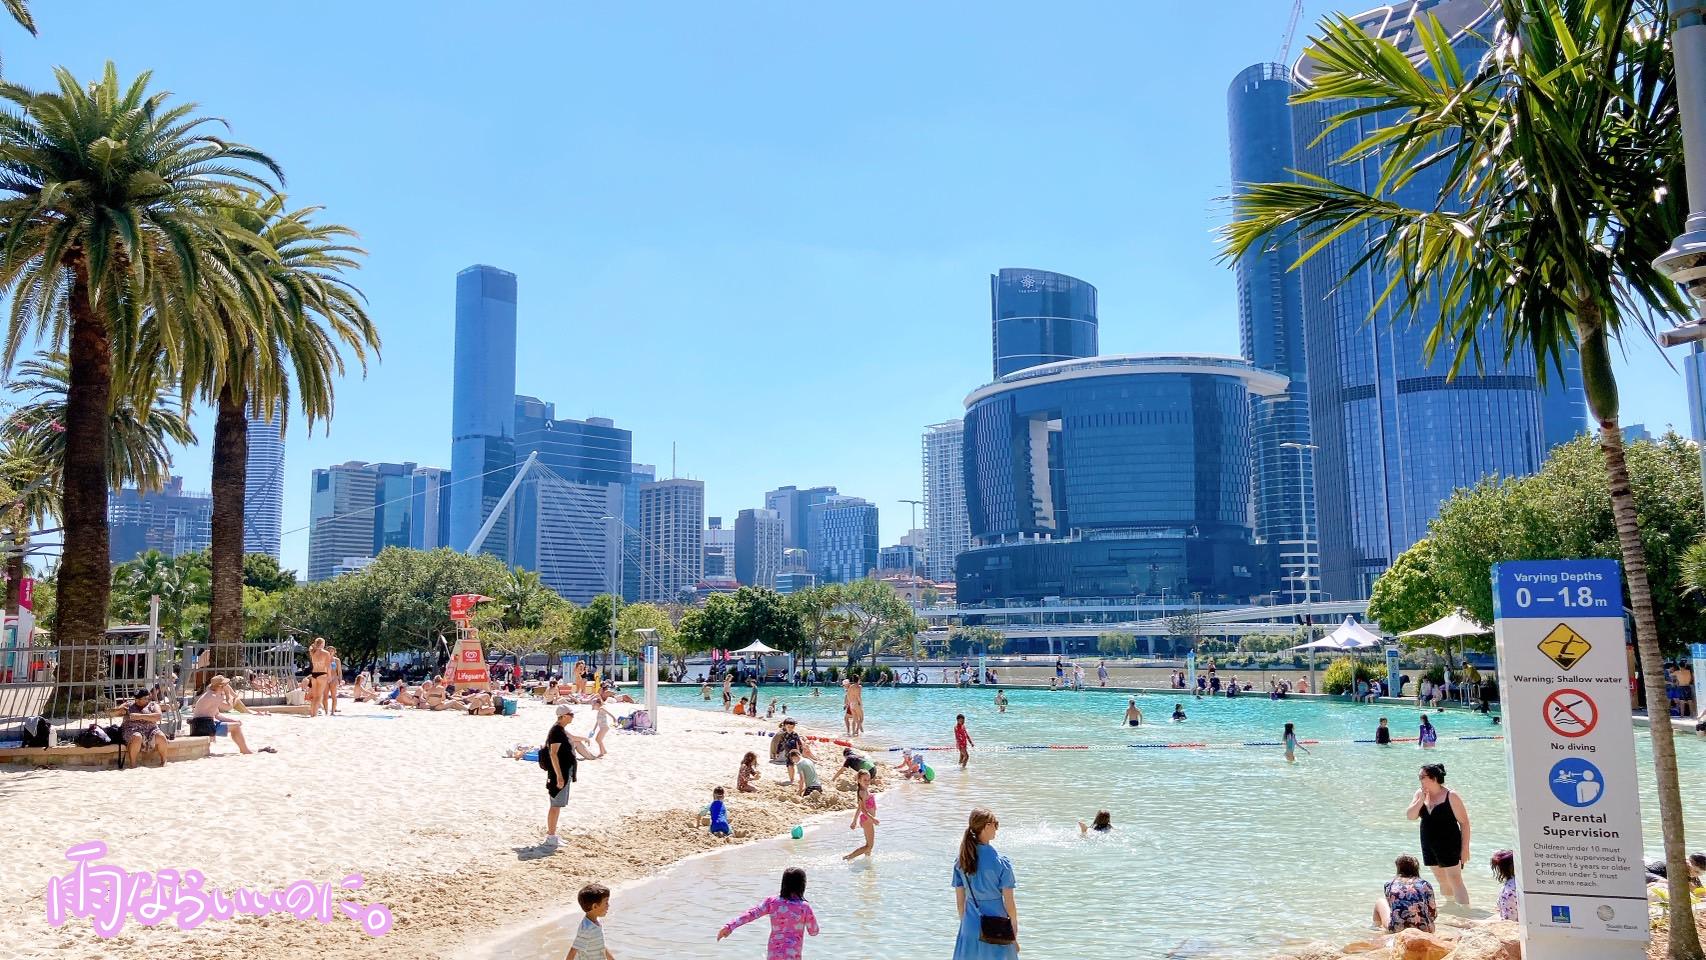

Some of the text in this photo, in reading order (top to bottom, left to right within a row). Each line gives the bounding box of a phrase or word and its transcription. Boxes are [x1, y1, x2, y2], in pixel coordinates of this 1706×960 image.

[1513, 572, 1603, 583] Varying Depths
[457, 672, 486, 681] Lifeguard
[1557, 675, 1593, 683] Shallow
[1551, 743, 1596, 752] No diving
[1552, 812, 1607, 824] Parental
[1543, 826, 1619, 839] Supervision
[1533, 843, 1565, 851] Children
[1545, 852, 1574, 860] actively
[1575, 854, 1616, 862] supervised
[1535, 868, 1567, 877] Children
[1568, 870, 1591, 878] under
